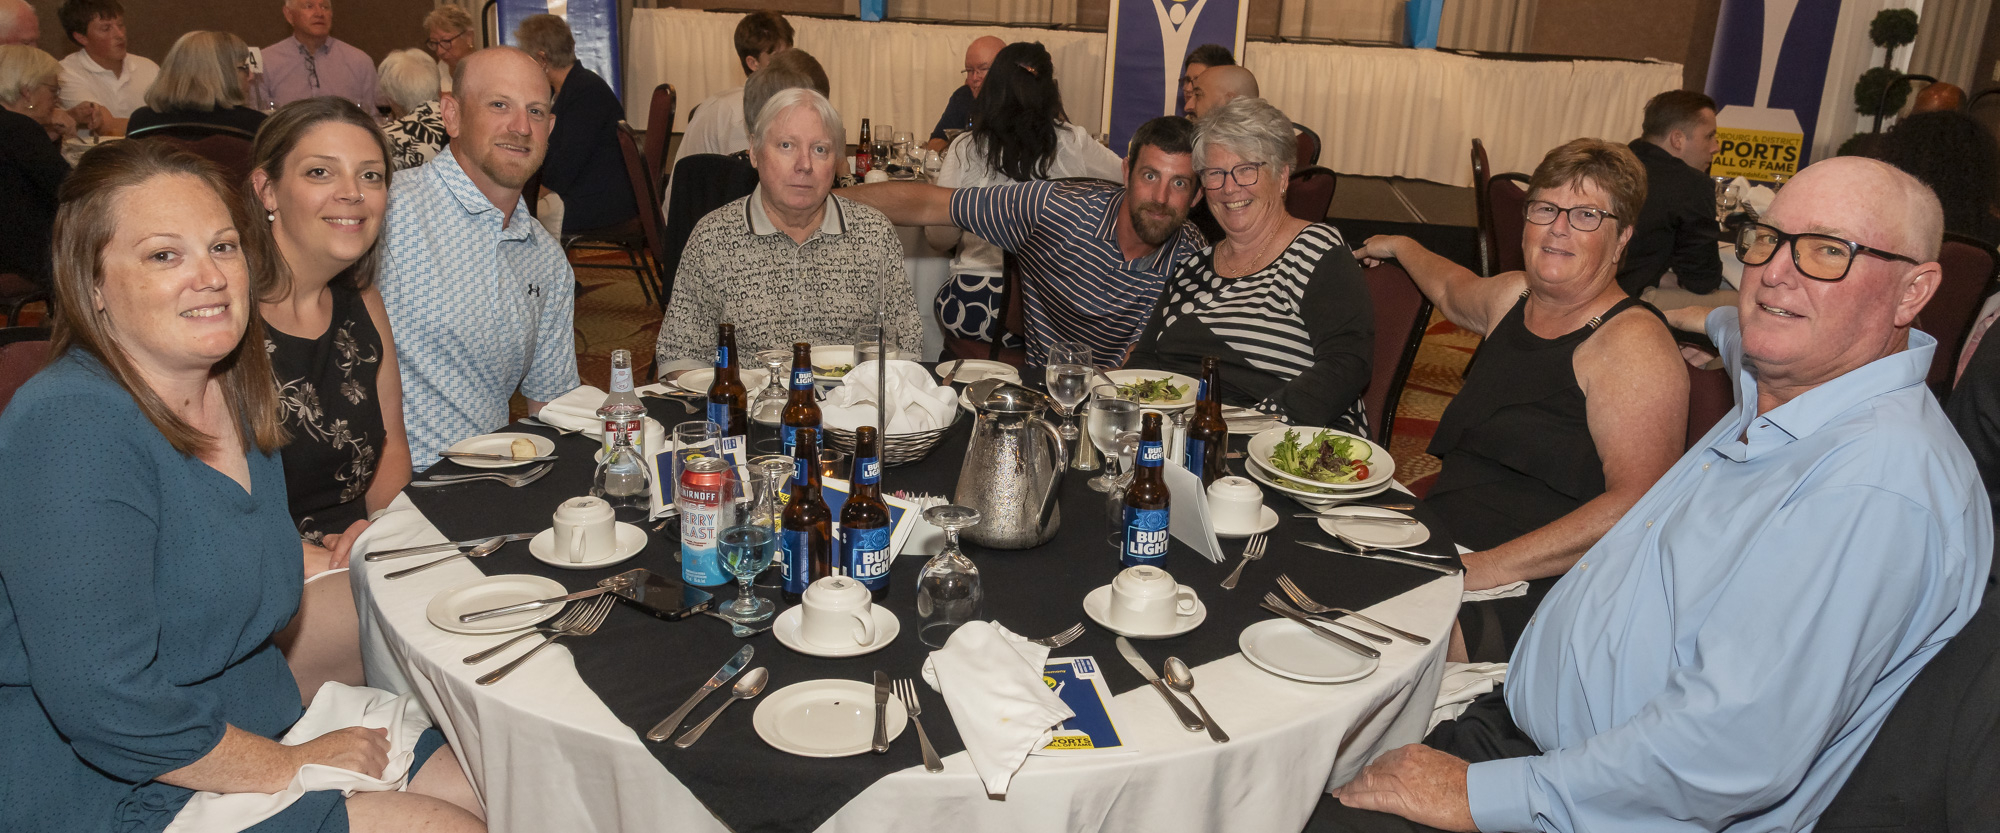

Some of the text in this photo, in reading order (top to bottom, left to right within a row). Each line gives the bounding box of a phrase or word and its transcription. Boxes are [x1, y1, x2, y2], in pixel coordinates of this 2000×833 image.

[1714, 132, 1751, 142] OBOURG
[1762, 136, 1800, 146] DISTRICT
[1720, 140, 1797, 162] PORTS
[1713, 156, 1794, 172] ALL OF FAME
[607, 421, 638, 430] SMOFF
[613, 431, 633, 441] IE
[1144, 452, 1164, 460] LIGHT
[1147, 446, 1163, 455] BUD
[864, 469, 881, 478] LIG
[867, 462, 880, 471] BU
[681, 488, 716, 501] MIRNOFF
[682, 525, 715, 540] LAST
[1136, 530, 1167, 544] BUD
[1130, 541, 1168, 555] LIGHT
[862, 548, 890, 565] BUD
[855, 563, 891, 577] LIGH
